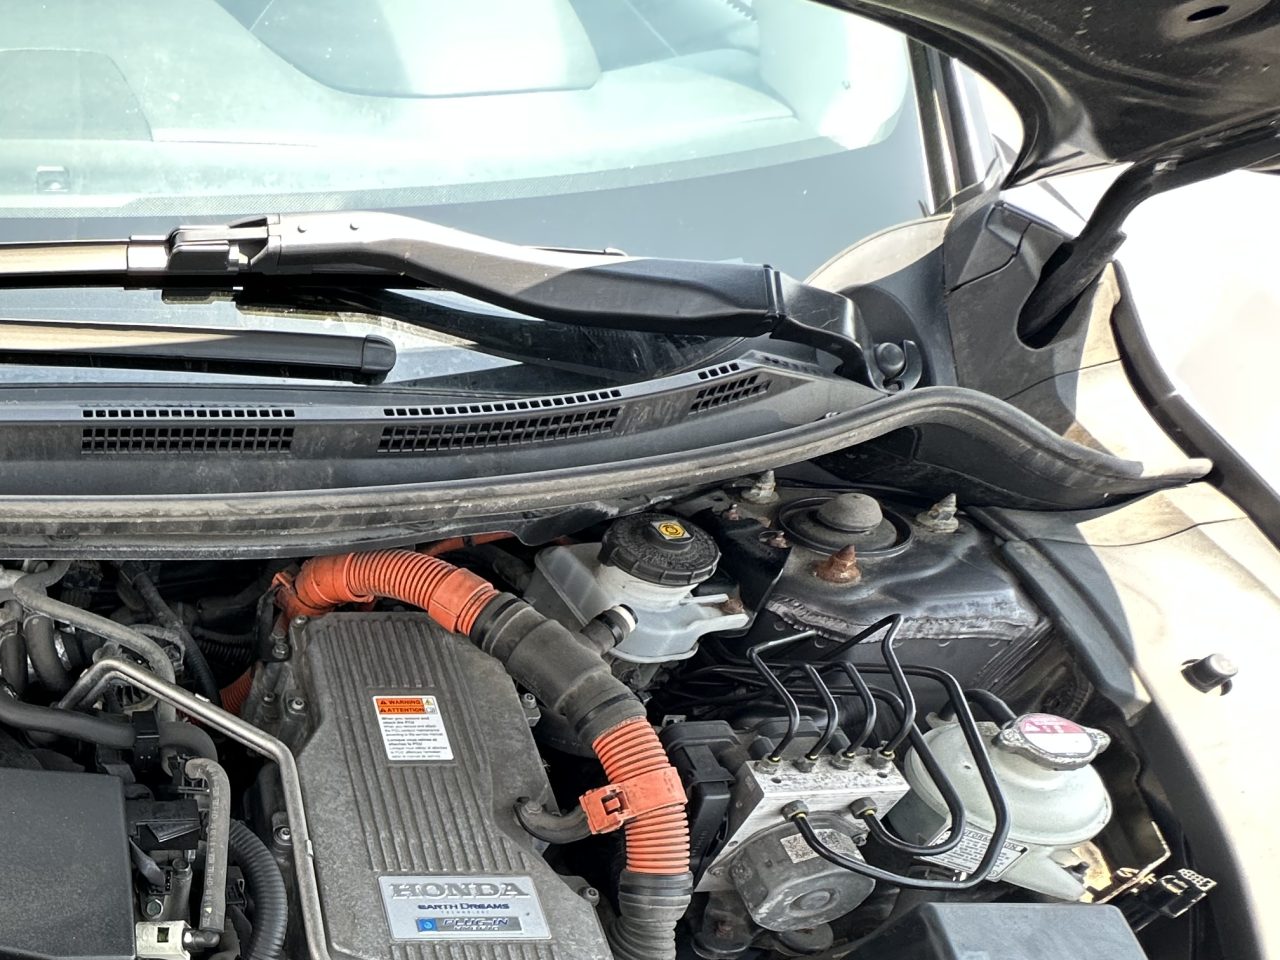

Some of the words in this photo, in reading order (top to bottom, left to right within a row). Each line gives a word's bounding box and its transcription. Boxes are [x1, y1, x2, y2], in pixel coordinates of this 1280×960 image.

[390, 882, 532, 900] HONDA
[460, 902, 510, 910] DREAMS
[442, 918, 509, 926] PLUG-IN
